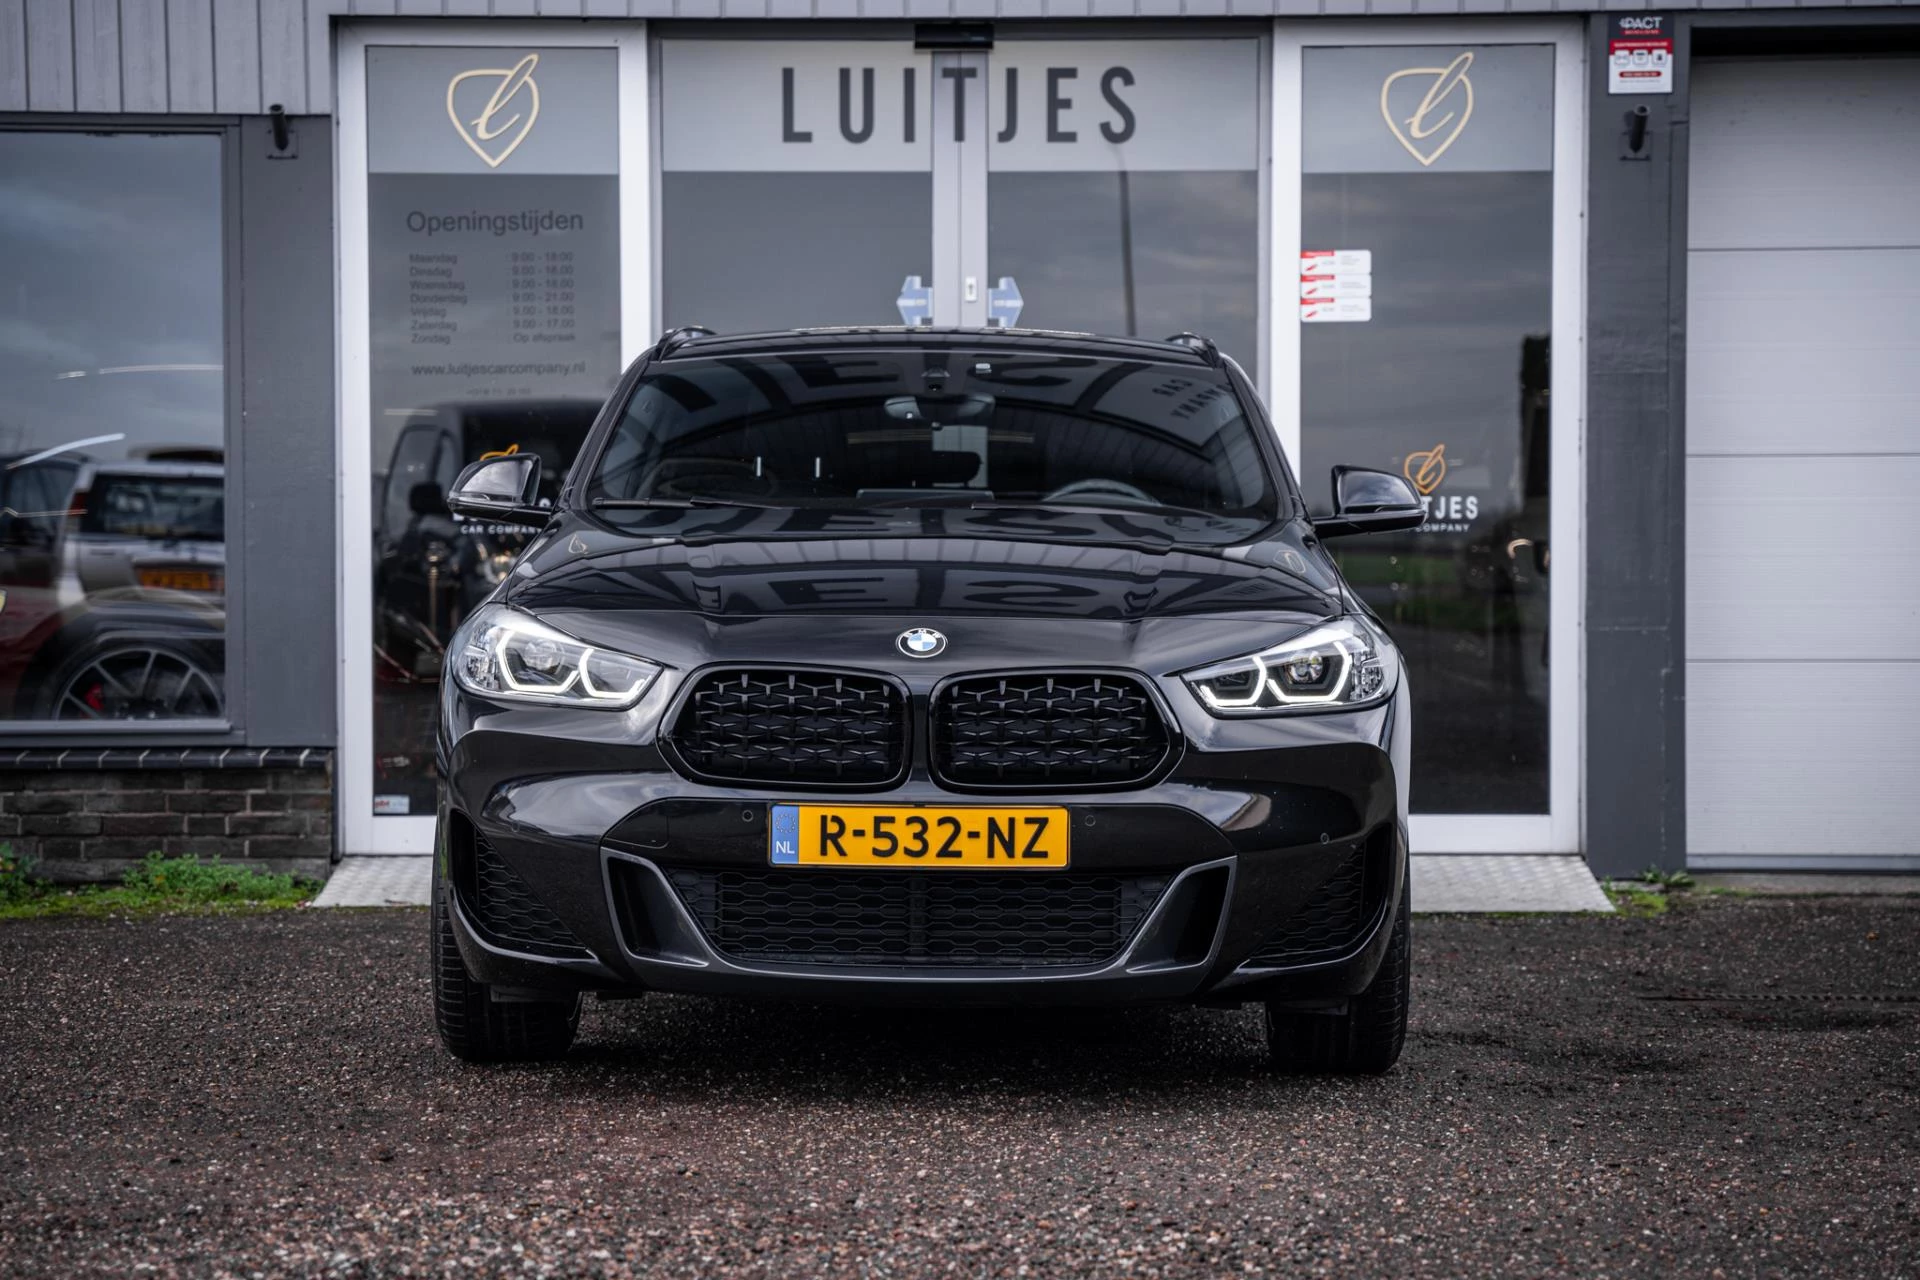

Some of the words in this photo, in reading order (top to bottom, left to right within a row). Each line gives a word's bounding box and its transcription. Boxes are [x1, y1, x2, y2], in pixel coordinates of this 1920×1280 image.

[782, 66, 1136, 144] LUITJES
[407, 210, 584, 237] Openingstijden
[411, 362, 586, 377] www.luitjescarcompany.nl
[461, 525, 484, 534] CAR
[775, 840, 795, 854] NL
[818, 814, 1050, 859] R-532-NZ
